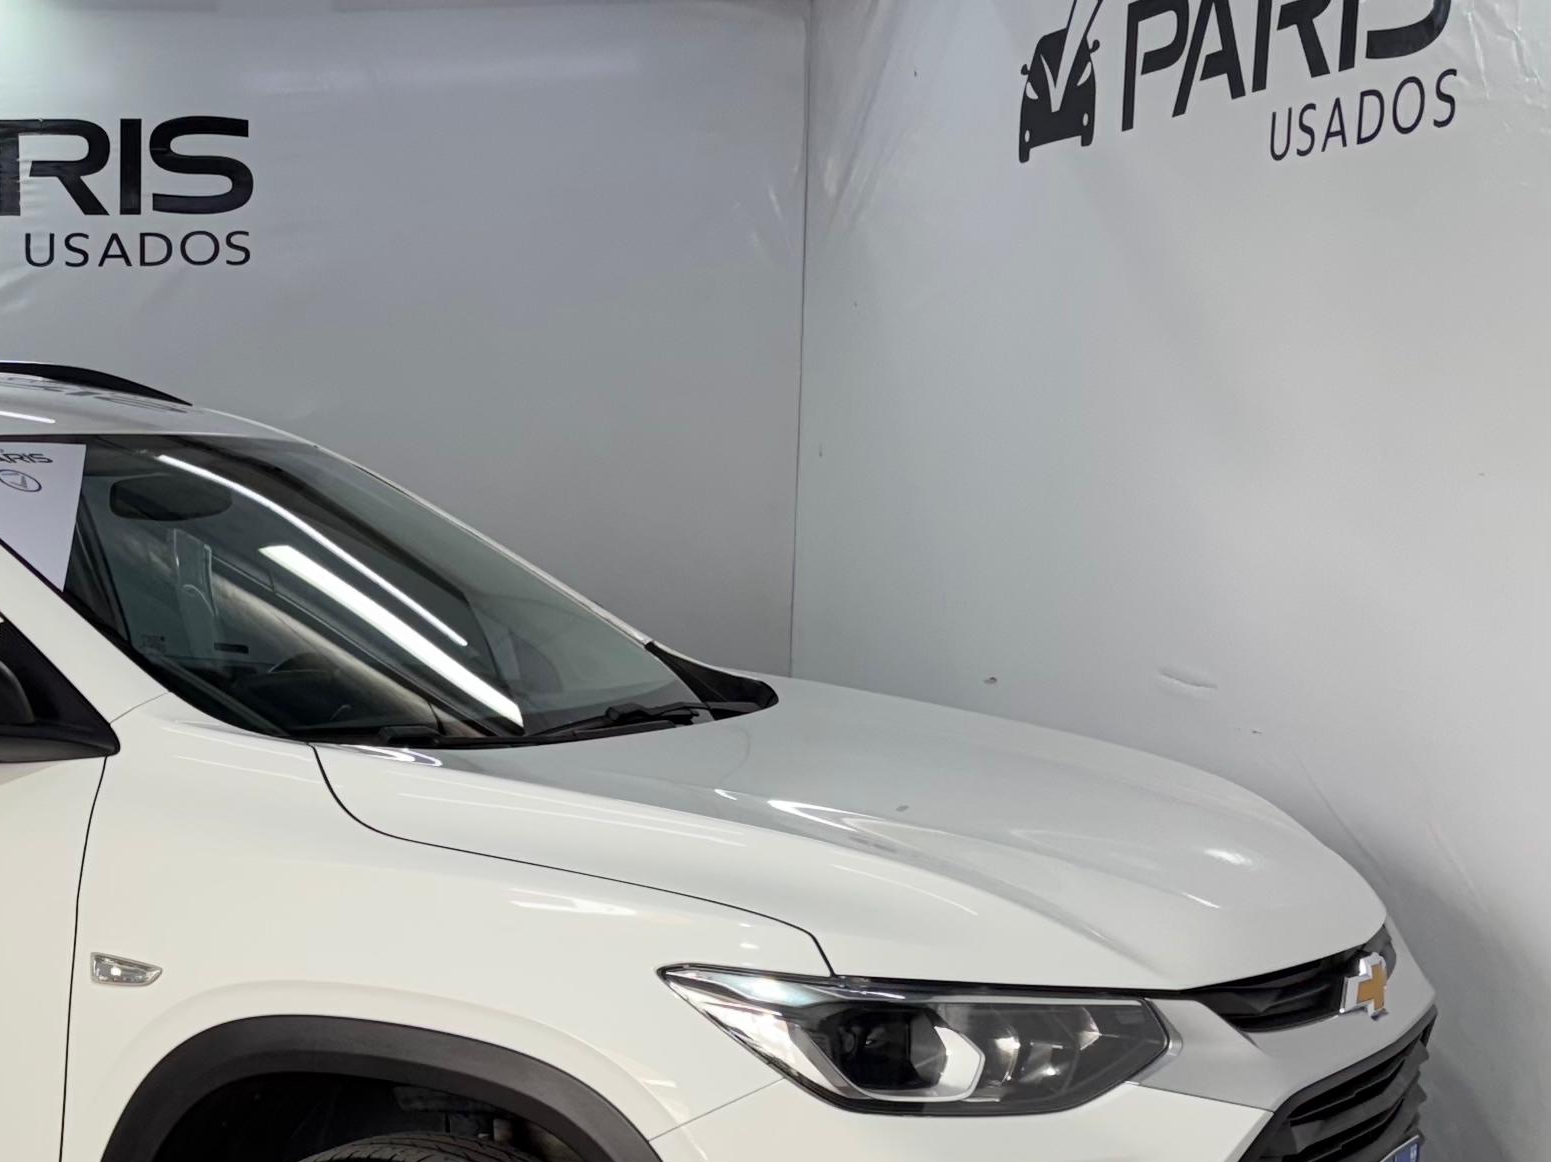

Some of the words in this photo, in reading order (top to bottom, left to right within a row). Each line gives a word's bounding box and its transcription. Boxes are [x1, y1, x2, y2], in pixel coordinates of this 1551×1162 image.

[1121, 0, 1451, 131] PAR
[1268, 68, 1458, 161] USADOS
[23, 230, 251, 268] USADOS
